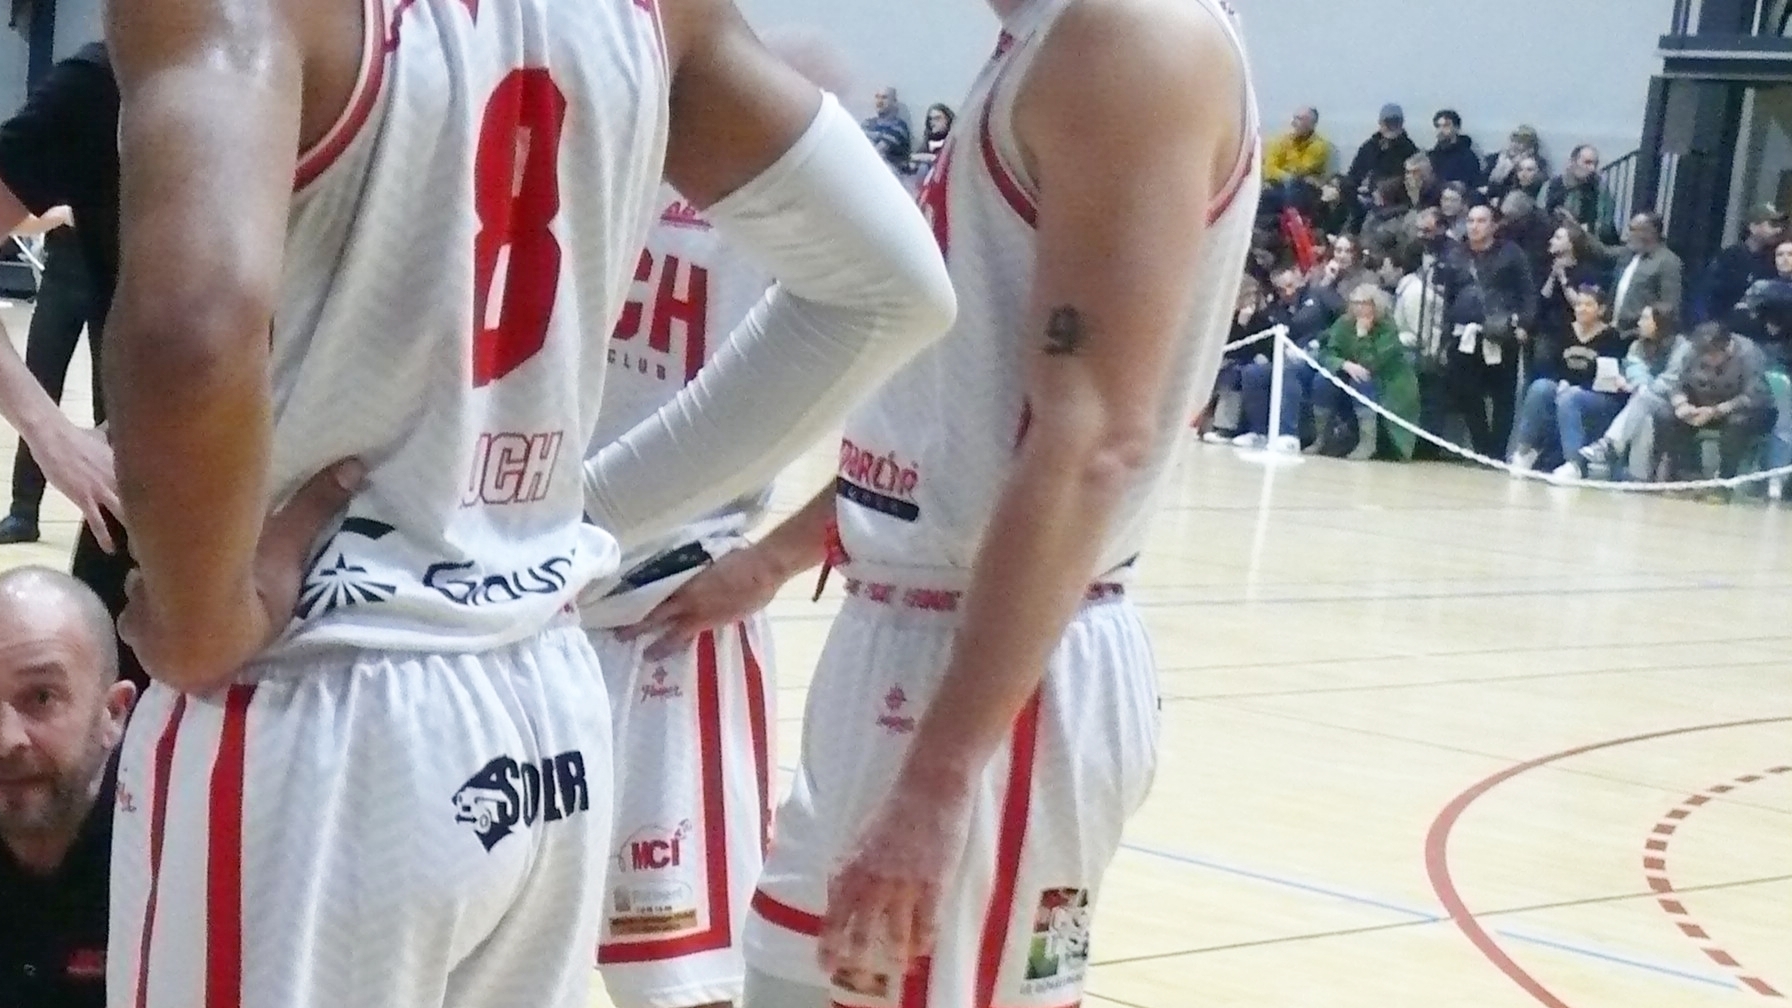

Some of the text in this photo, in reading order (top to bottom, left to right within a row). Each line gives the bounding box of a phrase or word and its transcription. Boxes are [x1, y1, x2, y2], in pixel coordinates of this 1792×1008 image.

[473, 66, 566, 389] 8
[607, 347, 668, 381] CLUB
[460, 430, 563, 508] UCH
[631, 838, 680, 871] MCI
